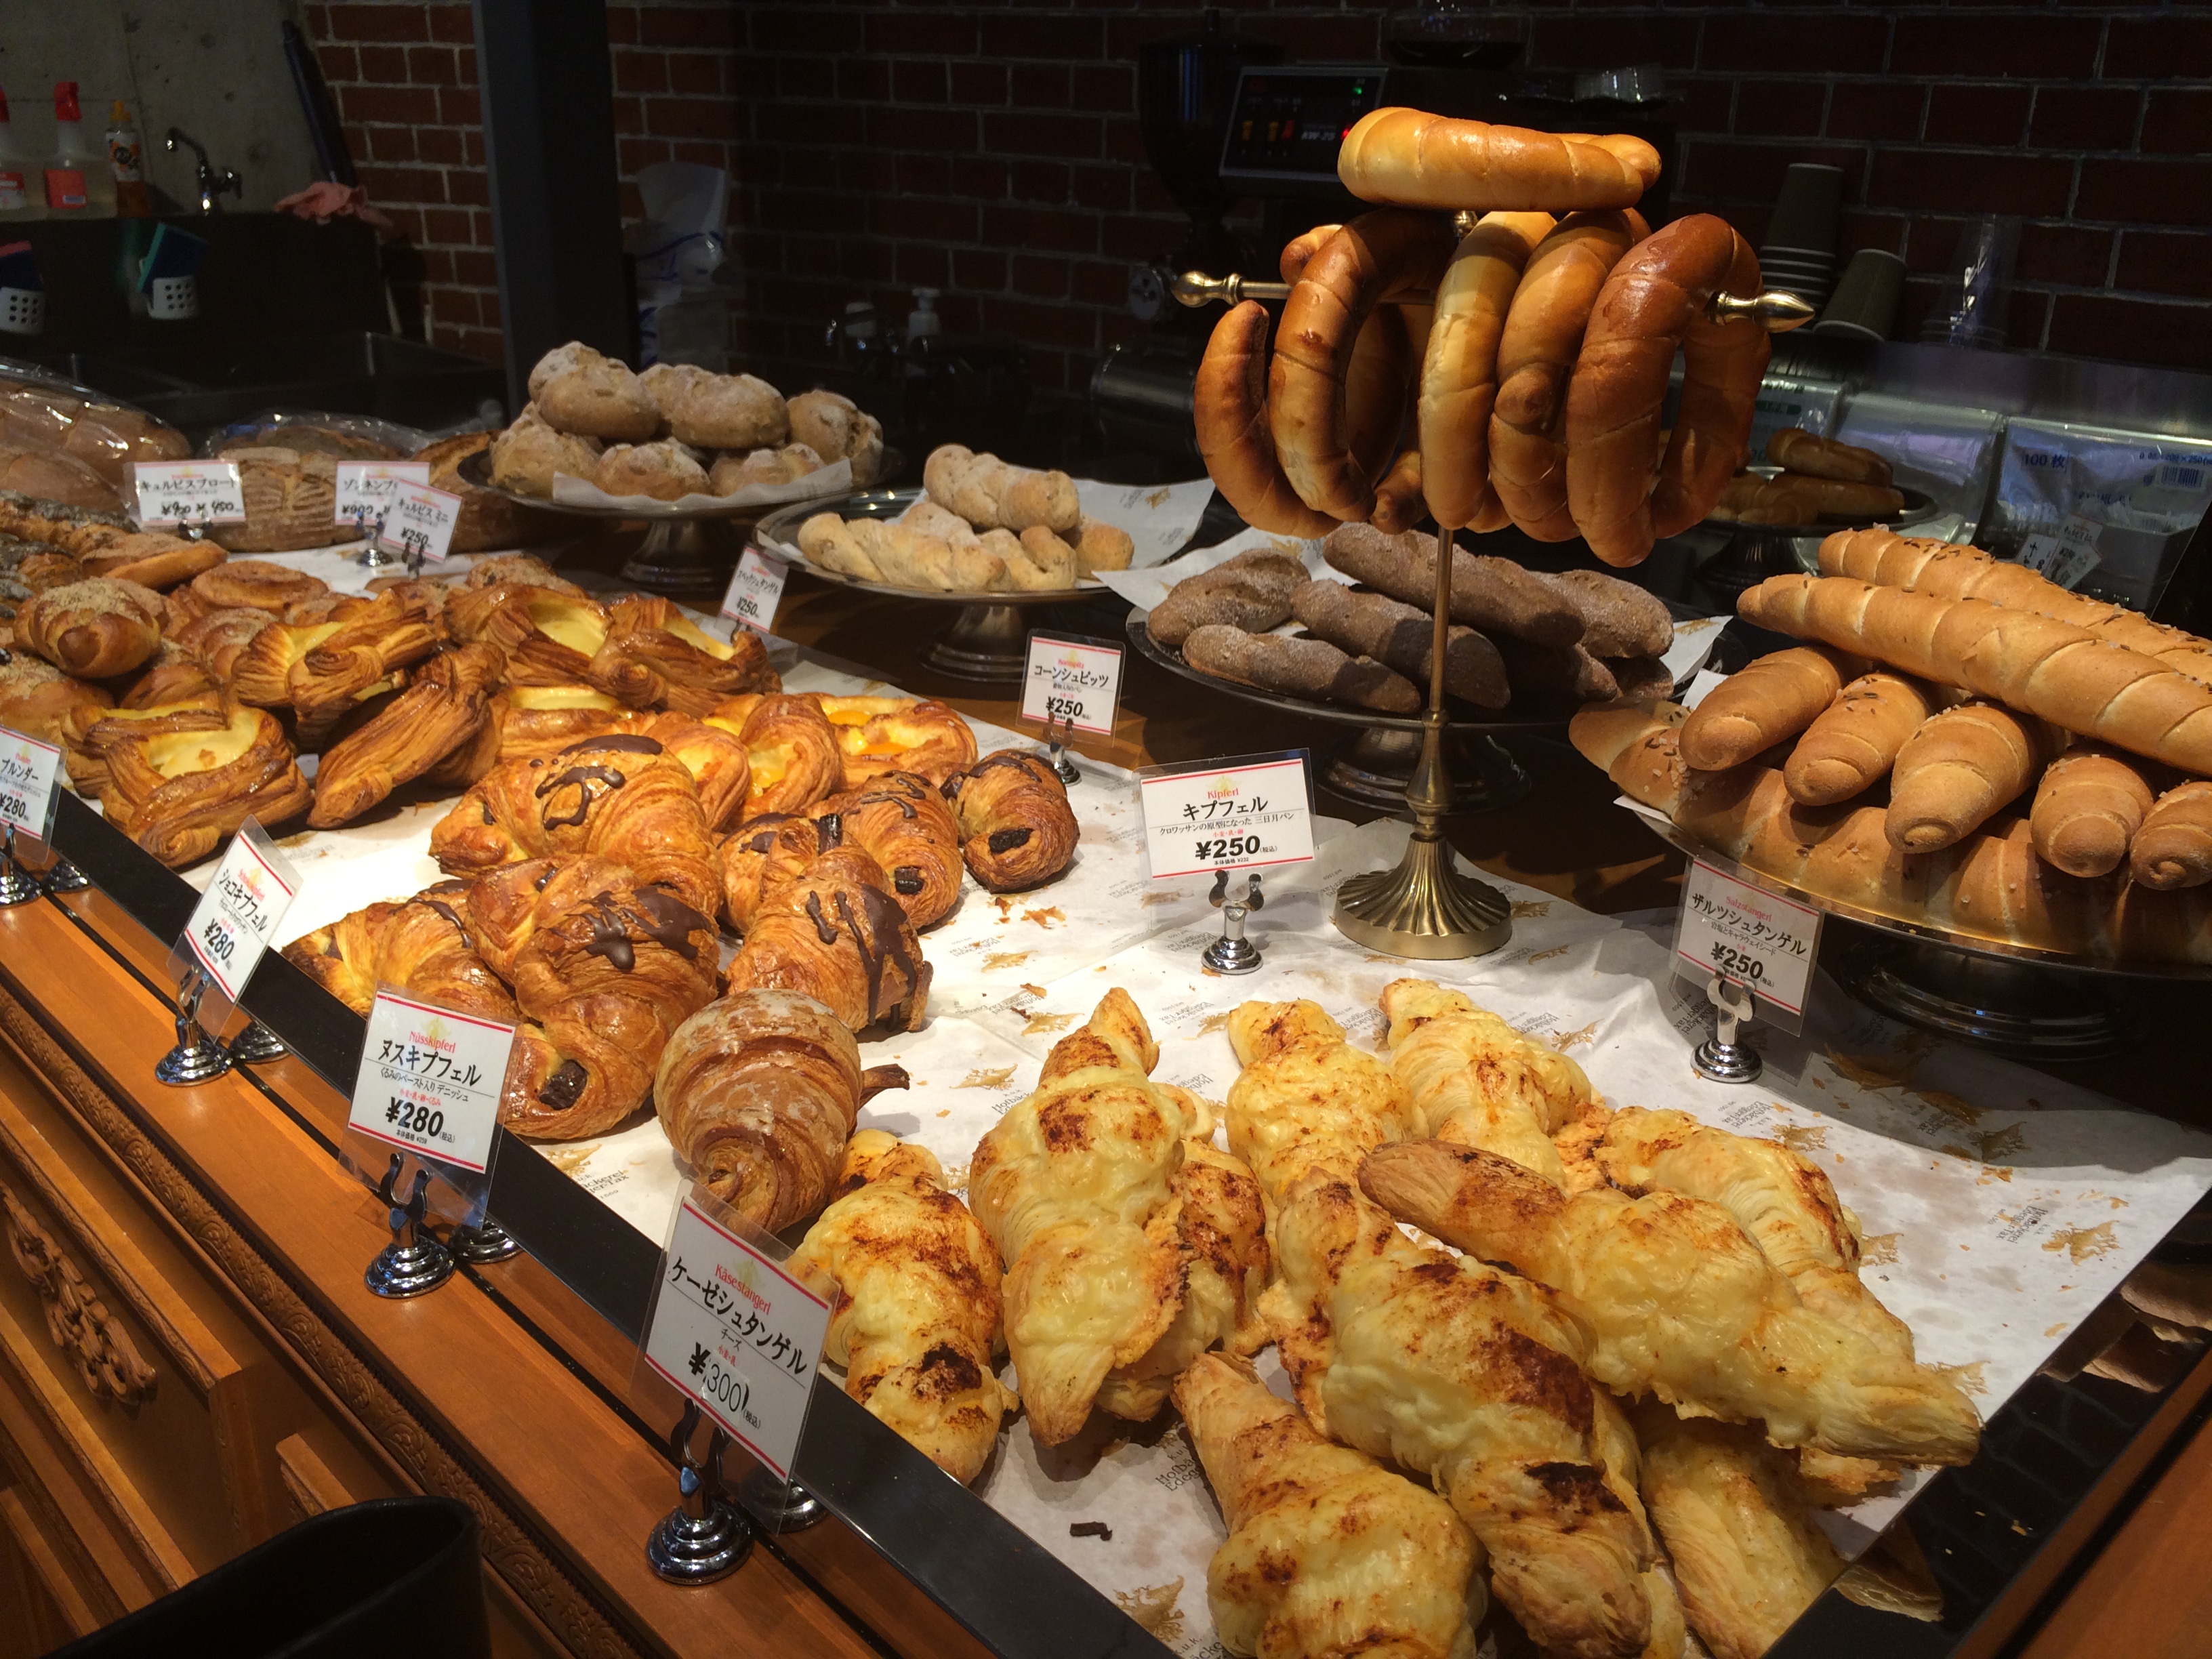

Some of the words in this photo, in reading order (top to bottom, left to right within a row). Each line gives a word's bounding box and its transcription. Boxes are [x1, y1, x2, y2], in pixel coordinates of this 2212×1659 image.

[400, 527, 429, 545] ¥250
[737, 596, 758, 616] ¥250
[1033, 664, 1109, 688] コーンシュピッツ
[1045, 696, 1084, 717] ¥250
[0, 793, 26, 817] ¥280
[1181, 798, 1267, 821] キプフェル
[1207, 787, 1238, 799] Kipferl
[1159, 817, 1252, 835] クロワッサンの原型になった
[1254, 812, 1294, 823] 三日月パン
[1193, 834, 1261, 861] ¥250
[218, 868, 267, 932] ショコキプフェル
[1725, 896, 1773, 922] Salzstangerl
[203, 918, 234, 961] ¥280
[1693, 895, 1807, 955] ザルツシュタンゲル
[1709, 921, 1776, 956] 岩塩とキャラウェイシード
[1713, 941, 1764, 979] ¥250
[1519, 1014, 1559, 1035] Hofbäcker
[1673, 995, 1712, 1029] degger-Tax
[1681, 1002, 1718, 1036] ofbäckerei
[408, 1030, 456, 1053] Nüsskipferl
[378, 1040, 481, 1086] ヌスキプフェル
[380, 1067, 435, 1092] くるみのペースト入り
[436, 1084, 469, 1102] デニッシュ
[384, 1096, 445, 1136] ¥280
[2007, 1208, 2047, 1244] Hofbäckerei
[715, 1265, 771, 1315] Käsestangerl
[672, 1256, 807, 1375] ケーゼシュタンゲル
[688, 1342, 743, 1412] ¥300
